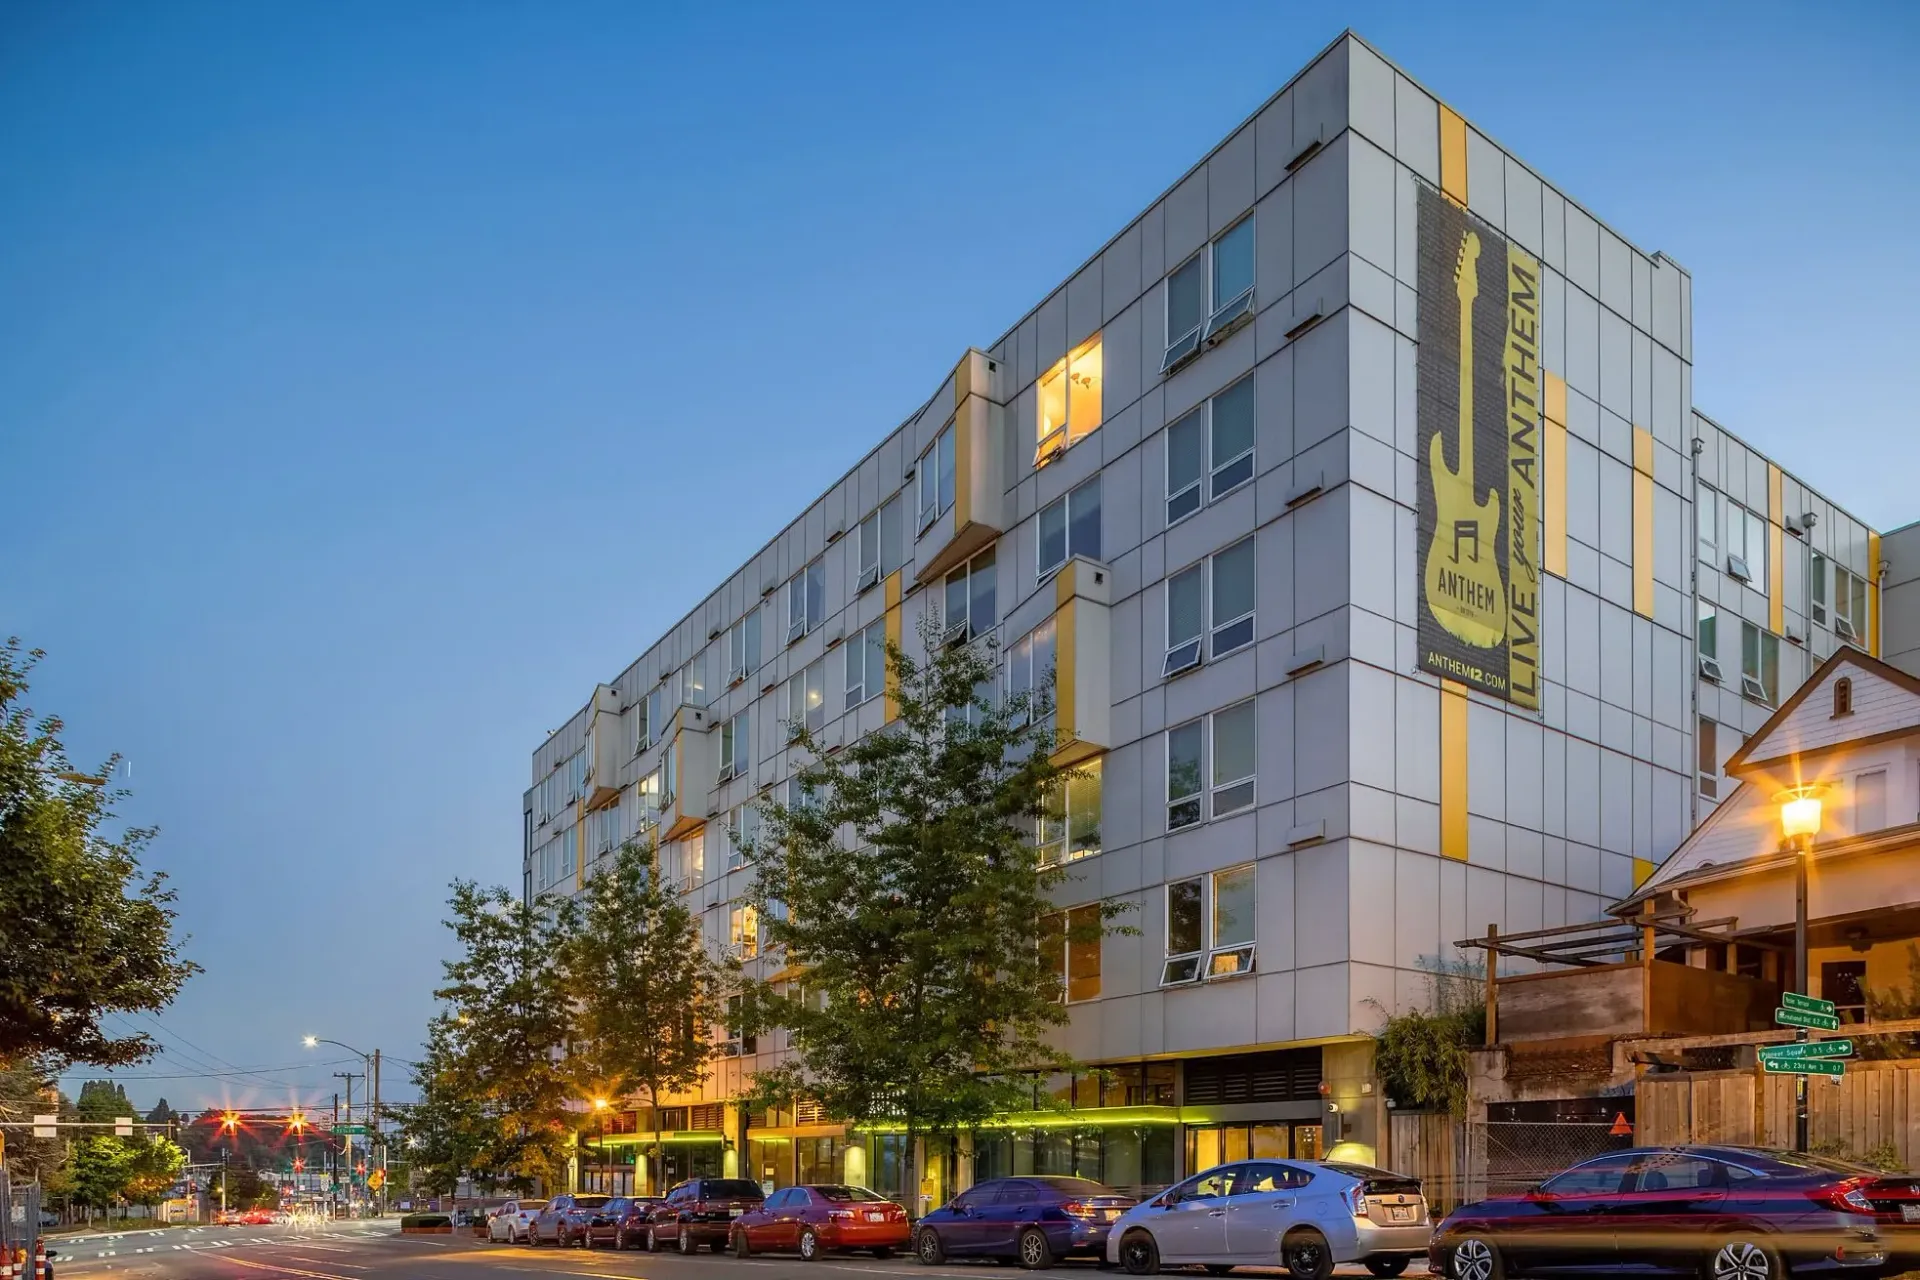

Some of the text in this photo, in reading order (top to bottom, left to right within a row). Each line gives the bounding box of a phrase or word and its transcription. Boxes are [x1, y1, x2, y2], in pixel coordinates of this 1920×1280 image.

[1511, 262, 1536, 697] LIVE your ANTHEM
[1438, 567, 1494, 614] ANTHEM
[1428, 651, 1506, 691] ANTHEM12.COM
